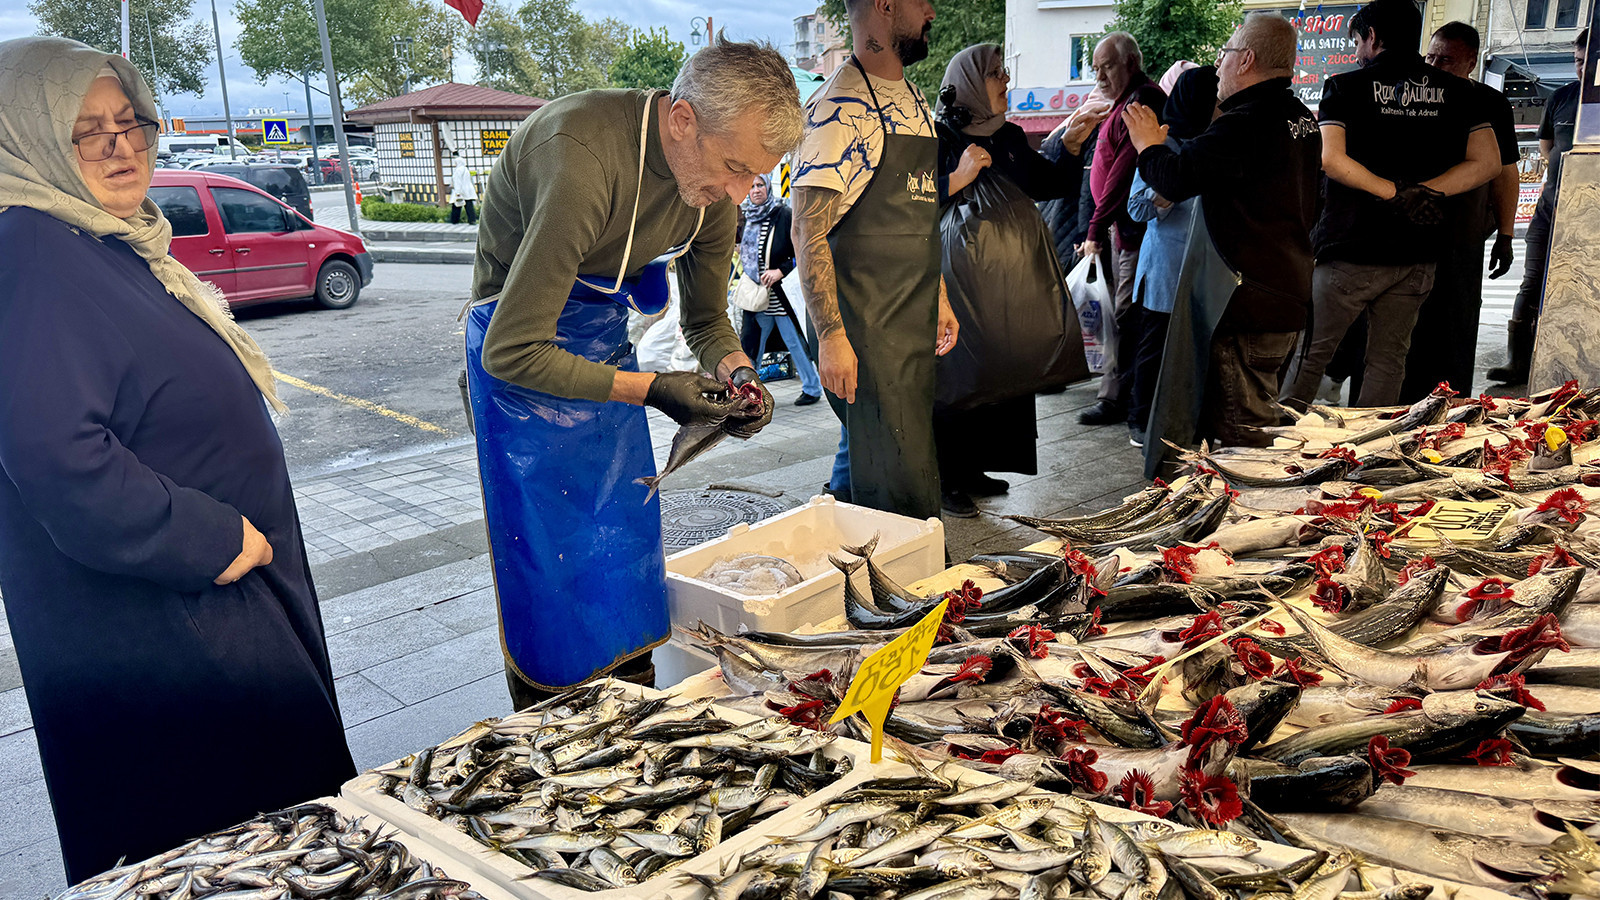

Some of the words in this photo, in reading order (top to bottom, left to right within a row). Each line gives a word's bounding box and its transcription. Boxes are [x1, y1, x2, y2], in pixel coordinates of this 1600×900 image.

[1299, 39, 1317, 50] LKA
[1318, 38, 1346, 51] SATIŞ
[1405, 109, 1417, 117] Tek
[483, 140, 507, 149] TAKS
[1418, 505, 1480, 531] 100
[1471, 504, 1512, 536] PALAMUT
